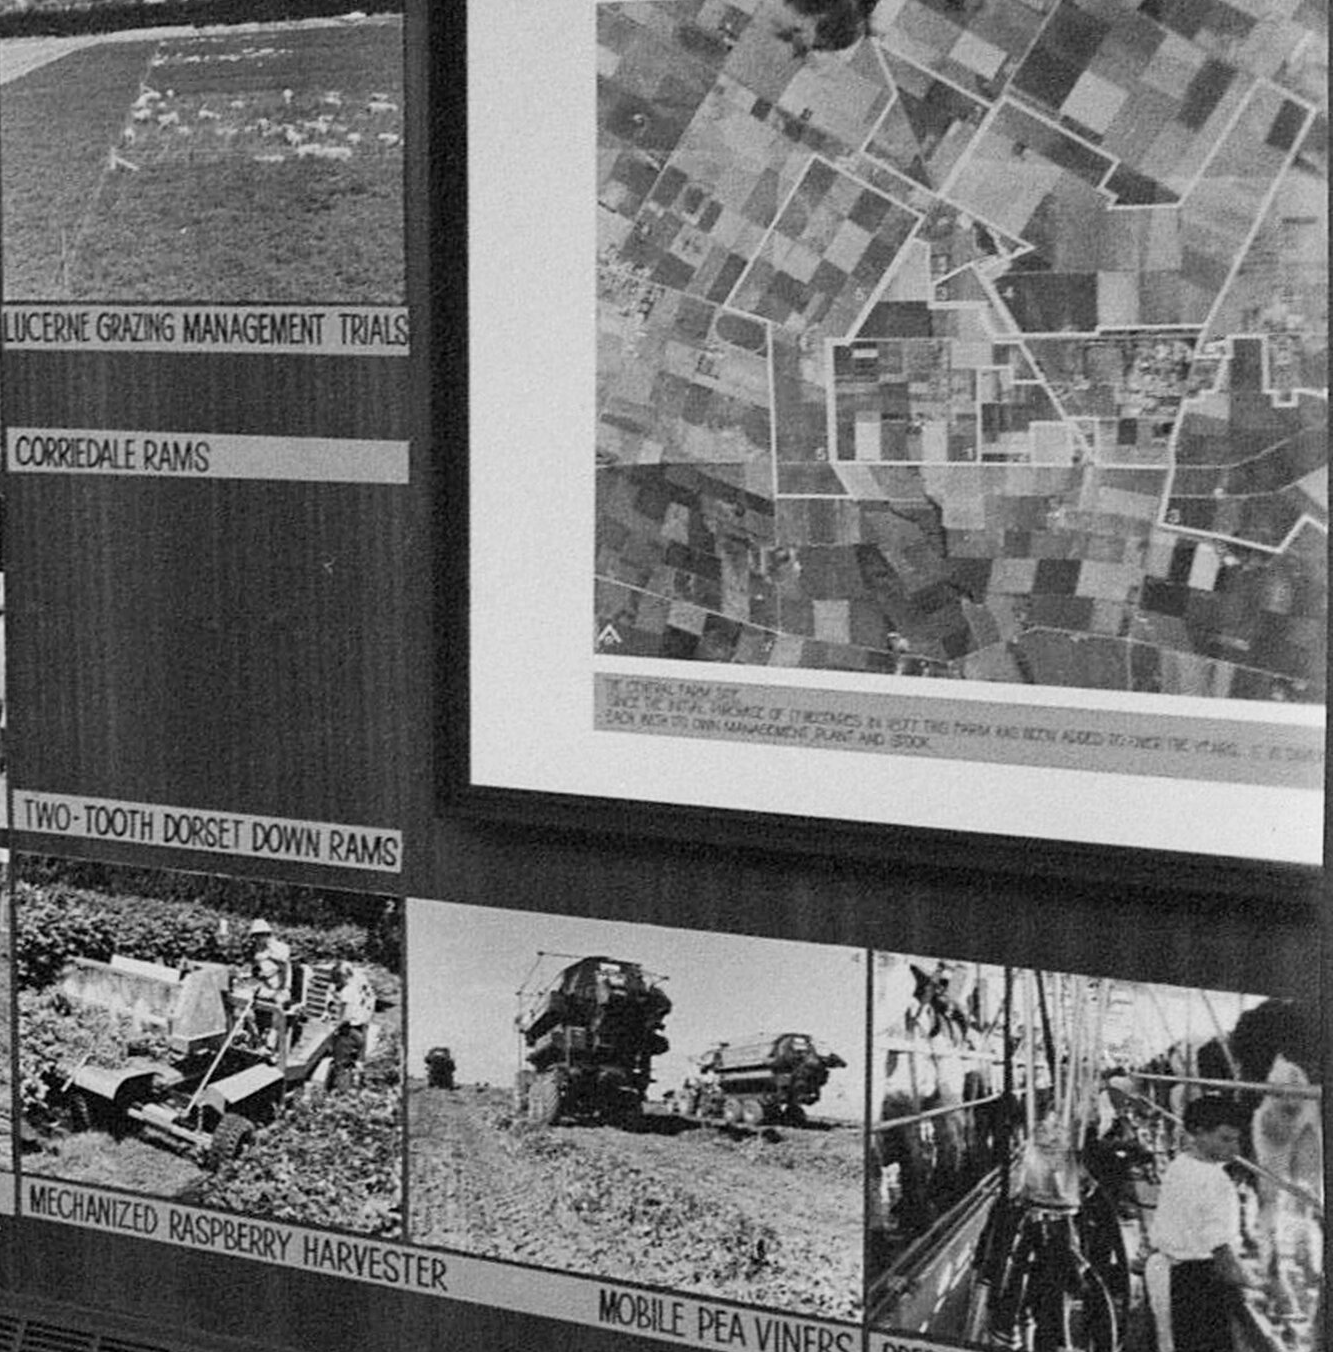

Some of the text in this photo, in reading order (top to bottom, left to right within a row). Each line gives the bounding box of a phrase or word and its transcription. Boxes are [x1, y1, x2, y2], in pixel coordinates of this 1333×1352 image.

[3, 312, 409, 347] LUCERNE GRAZING MANAGEMENT TRIALS
[15, 435, 210, 473] CORRIEDALE RAMS
[24, 799, 399, 867] TWO-TOOTH DORSET DOWN RAMS
[31, 1183, 448, 1291] MECHANIZED RASPBERRY HARVESTER
[599, 1288, 686, 1337] MOBILE
[698, 1305, 747, 1347] PEA
